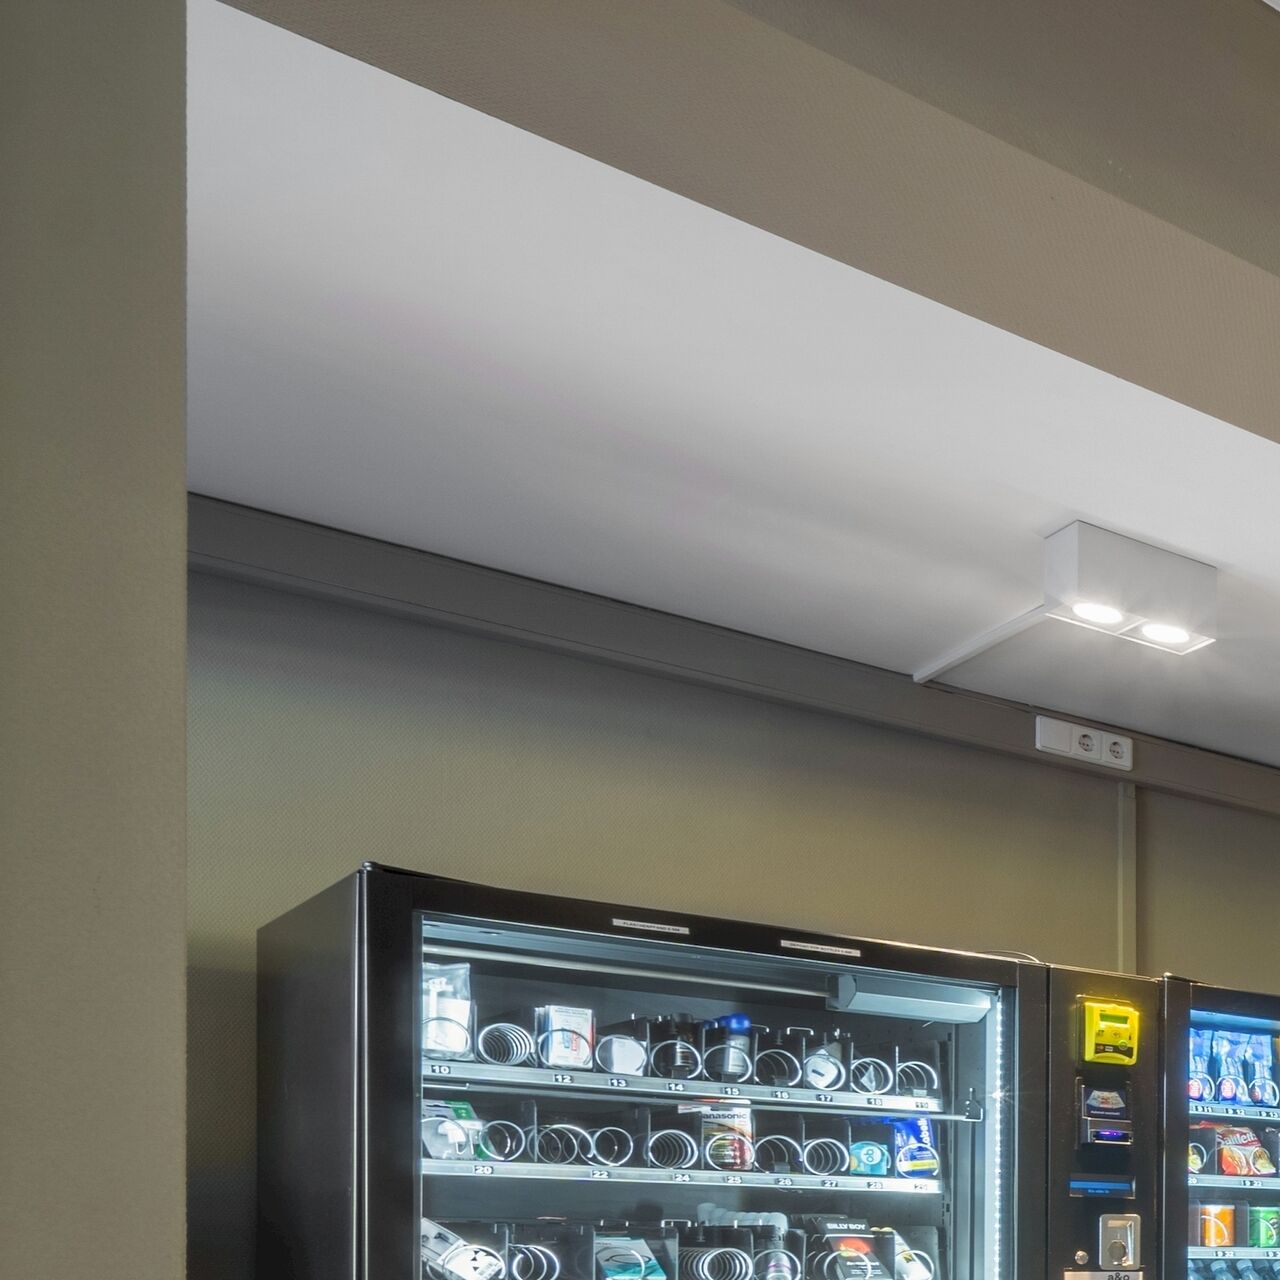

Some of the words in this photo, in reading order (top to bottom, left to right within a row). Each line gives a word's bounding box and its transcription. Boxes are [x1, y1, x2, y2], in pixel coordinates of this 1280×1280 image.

[433, 1066, 450, 1074] 10
[555, 1075, 572, 1083] 12
[610, 1078, 627, 1087] 13
[669, 1083, 684, 1091] 14
[725, 1087, 740, 1096] 15
[776, 1091, 790, 1099] 16
[818, 1094, 832, 1102] 17
[702, 1112, 748, 1120] anasonic
[475, 1166, 492, 1175] 20
[593, 1170, 608, 1178] 22
[676, 1174, 690, 1182] 24
[727, 1176, 742, 1184] 25
